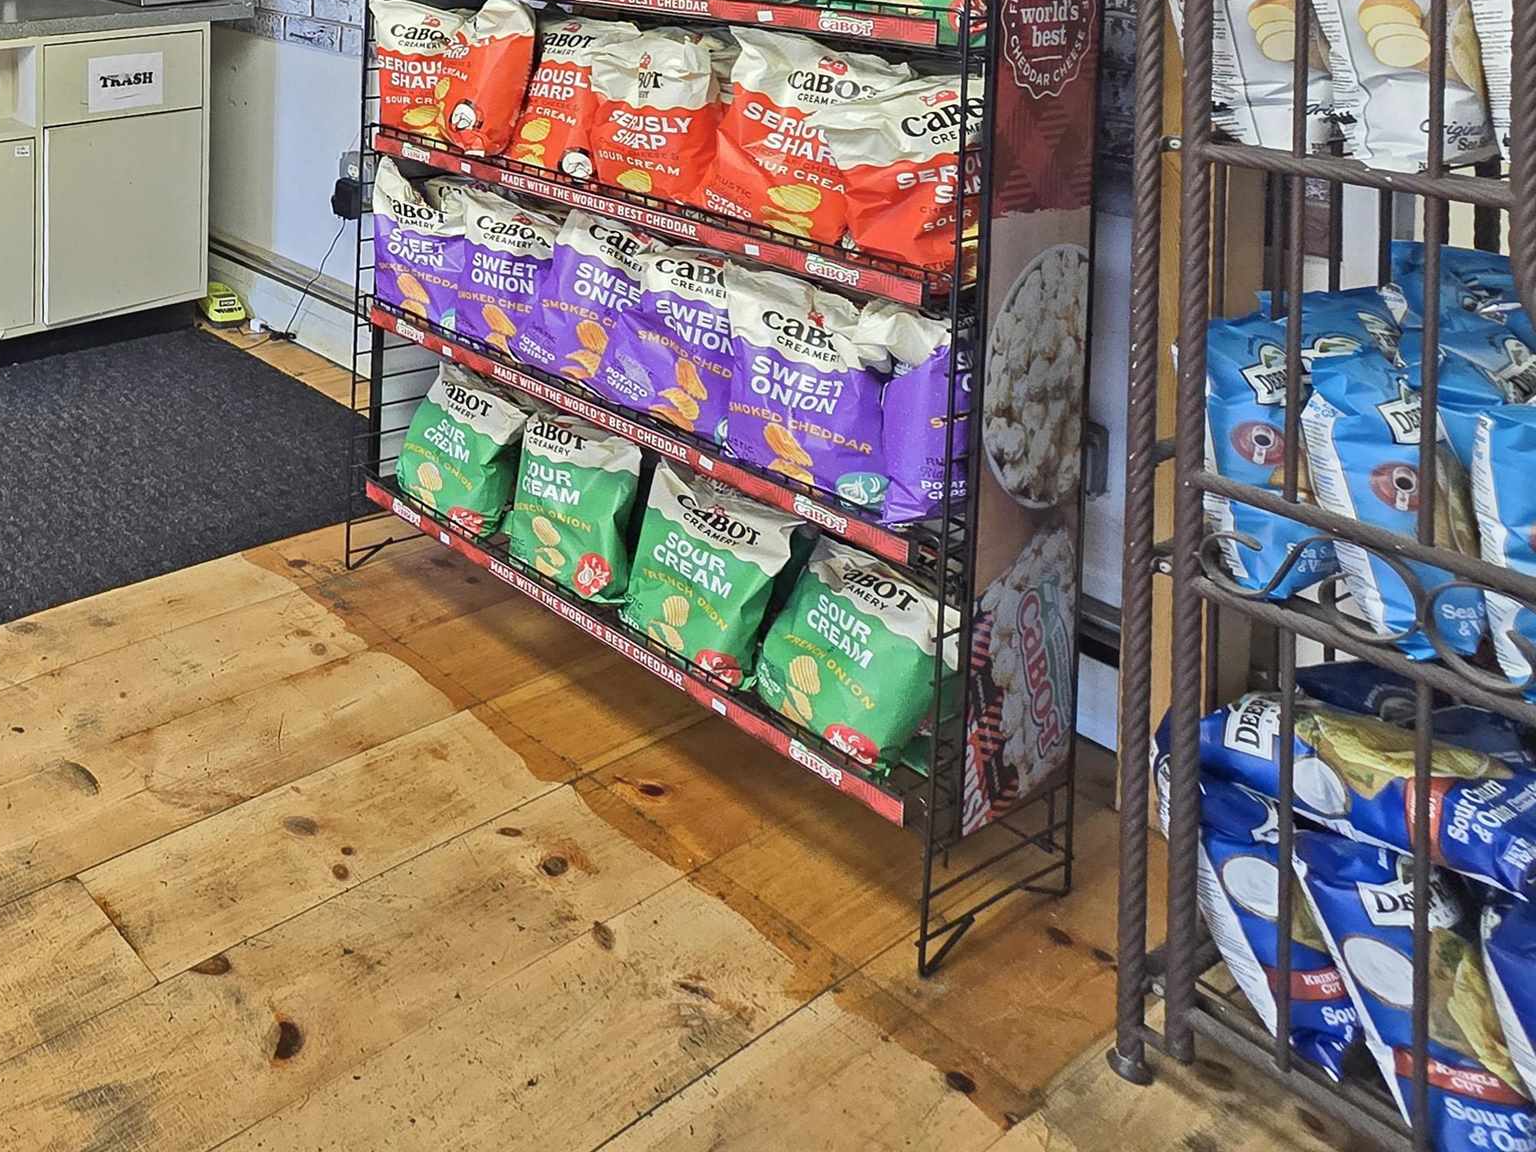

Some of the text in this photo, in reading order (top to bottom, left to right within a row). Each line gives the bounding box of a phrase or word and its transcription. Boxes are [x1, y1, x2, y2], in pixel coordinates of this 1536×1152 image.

[1020, 0, 1080, 24] world's
[1031, 24, 1067, 48] best
[1010, 31, 1087, 86] CHEDDAR CHEESE
[99, 71, 154, 88] TRASH
[536, 106, 577, 126] CREAM
[626, 155, 680, 177] CREAM
[500, 171, 697, 236] MADE WITH THE WORLD'S BEST CHEDDAR
[704, 188, 753, 218] POTATO
[483, 232, 533, 249] CREAMERY
[471, 251, 538, 278] SWEET
[471, 267, 535, 295] ONION
[541, 299, 599, 322] SMOKED
[605, 365, 648, 398] POTATO
[752, 355, 844, 398] SWEET
[493, 365, 687, 459] MADE WITH THE WORLD'S BEST CHEDDAR
[729, 400, 782, 423] SMOKED
[751, 376, 837, 415] ONION
[787, 418, 872, 455] CHEDDAR
[682, 512, 741, 547] CREAMERY
[665, 530, 726, 577] SOUR
[642, 568, 693, 599] FRENCH
[652, 543, 733, 599] CREAM
[489, 560, 682, 685] MADE WITH THE WORLD'S BEST CHEDDAR
[816, 594, 872, 644] SOUR
[784, 633, 825, 662] FRENCH
[806, 612, 874, 670] CREAM
[826, 658, 876, 711] ONION
[1444, 1095, 1511, 1132] Sour
